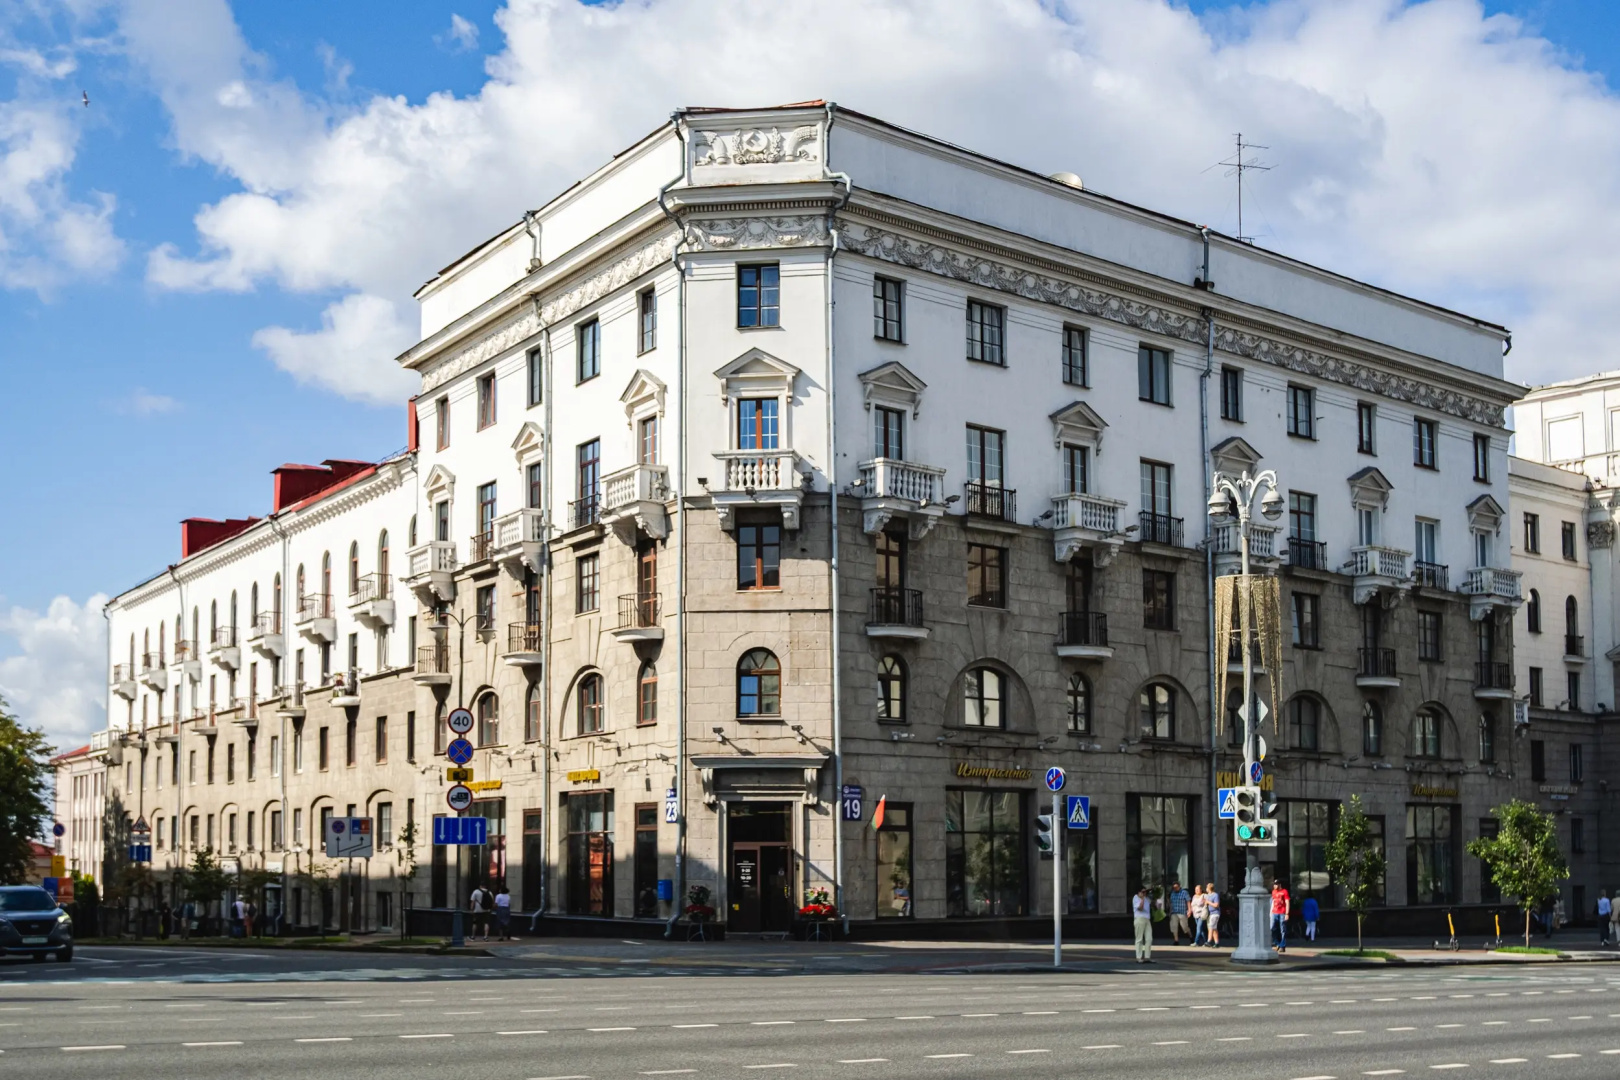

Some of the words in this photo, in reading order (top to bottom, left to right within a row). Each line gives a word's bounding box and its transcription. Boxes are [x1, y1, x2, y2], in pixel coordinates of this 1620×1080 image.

[453, 716, 469, 727] 40
[666, 802, 677, 821] 23
[844, 799, 860, 818] 19
